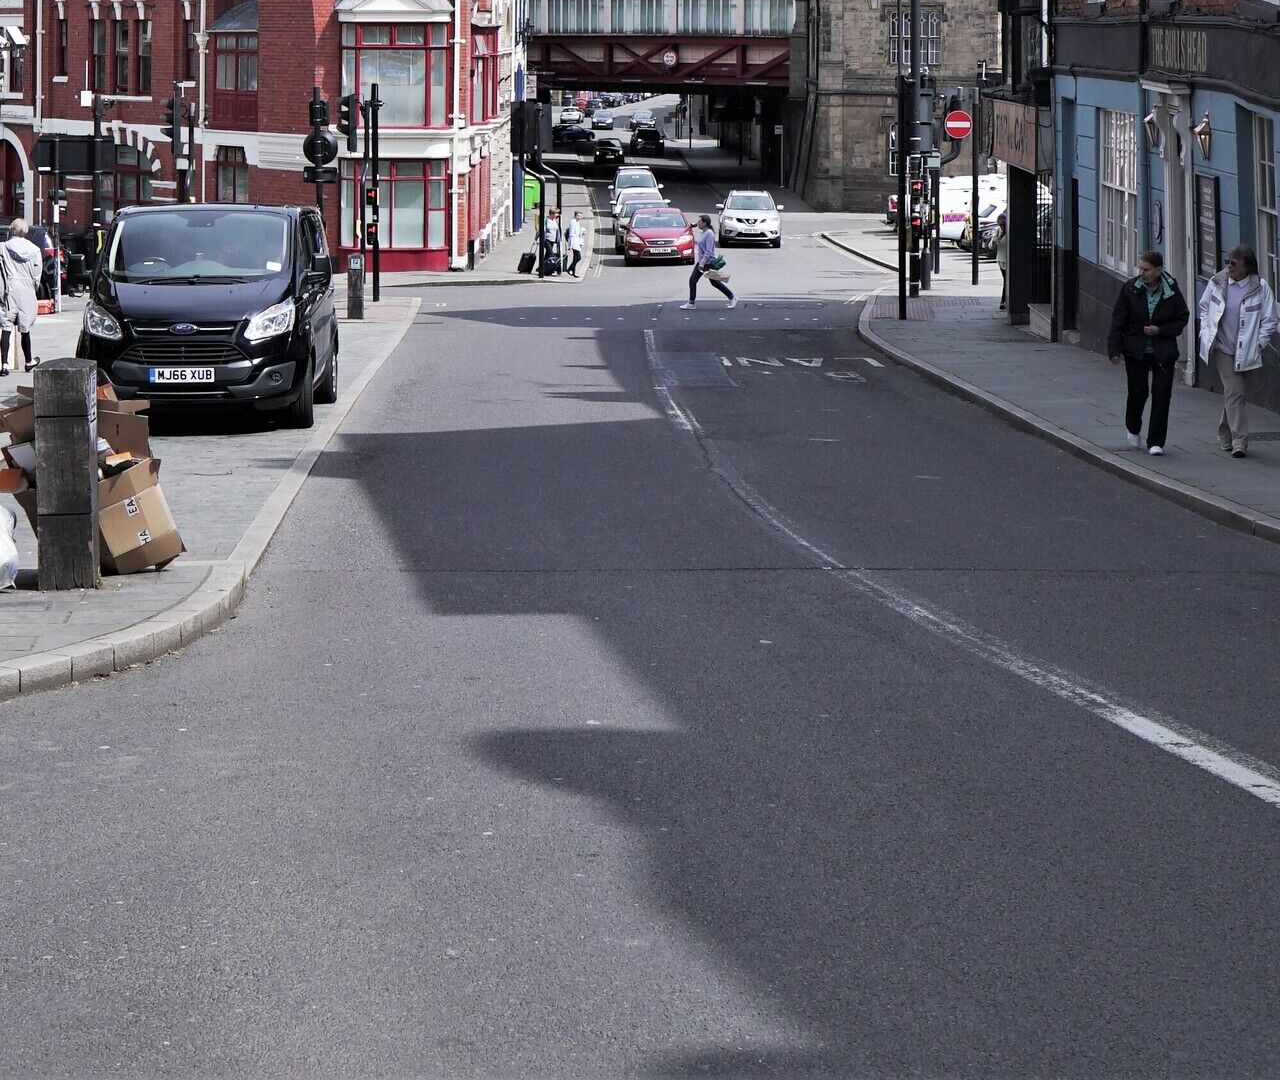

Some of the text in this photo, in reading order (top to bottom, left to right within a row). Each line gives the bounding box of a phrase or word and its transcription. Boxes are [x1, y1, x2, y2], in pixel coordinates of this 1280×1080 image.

[1152, 28, 1163, 67] THE
[1187, 30, 1207, 72] HEAD
[157, 369, 212, 381] MJ66 XUB
